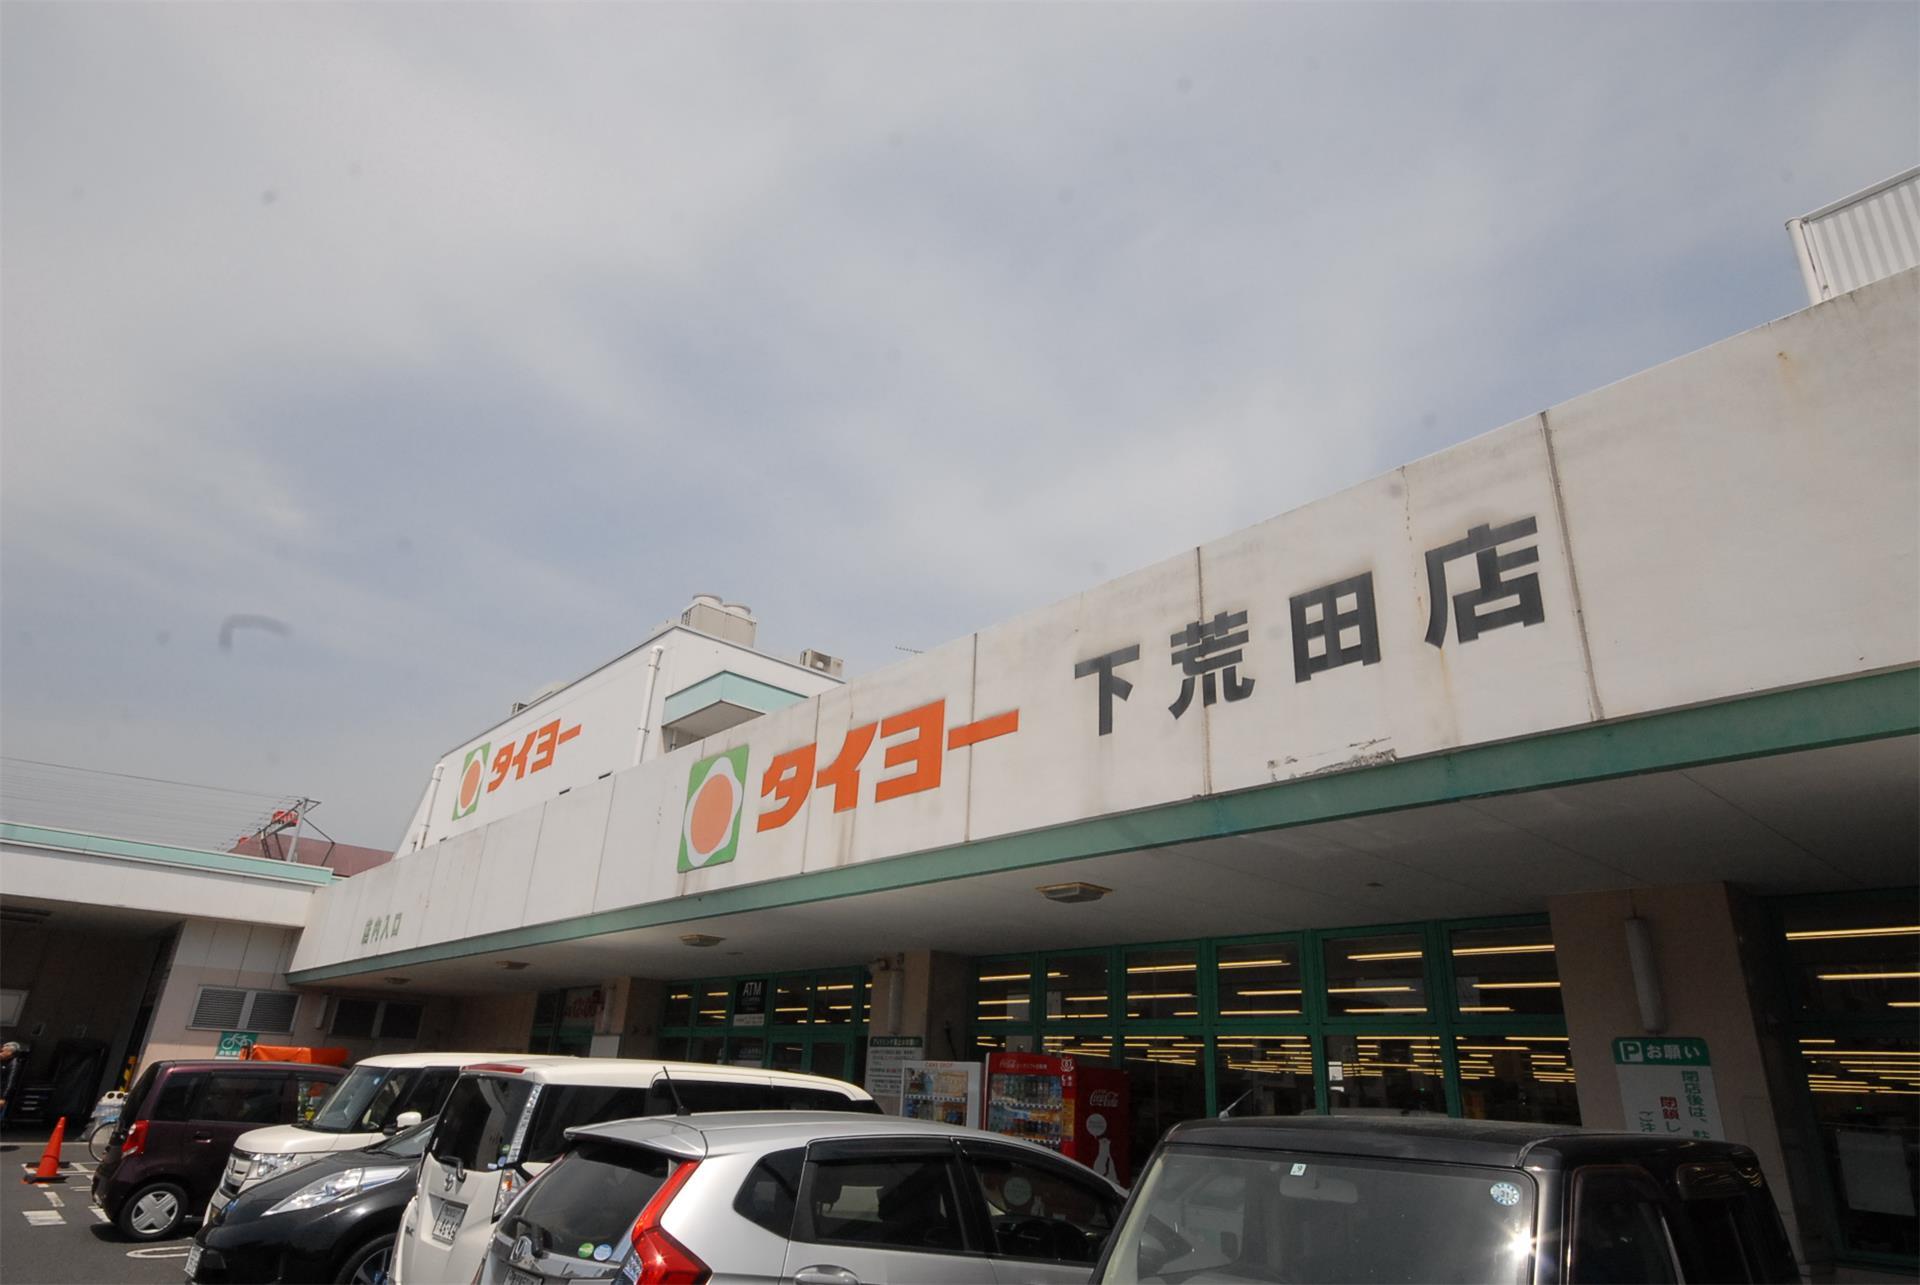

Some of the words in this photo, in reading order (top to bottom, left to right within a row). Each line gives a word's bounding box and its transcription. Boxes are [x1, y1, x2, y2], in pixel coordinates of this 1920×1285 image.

[1074, 516, 1545, 737] 下荒田店
[487, 718, 582, 793] タイヨー
[757, 698, 1020, 833] タイヨー
[742, 982, 762, 997] ATM
[1646, 1044, 1700, 1059] お願い
